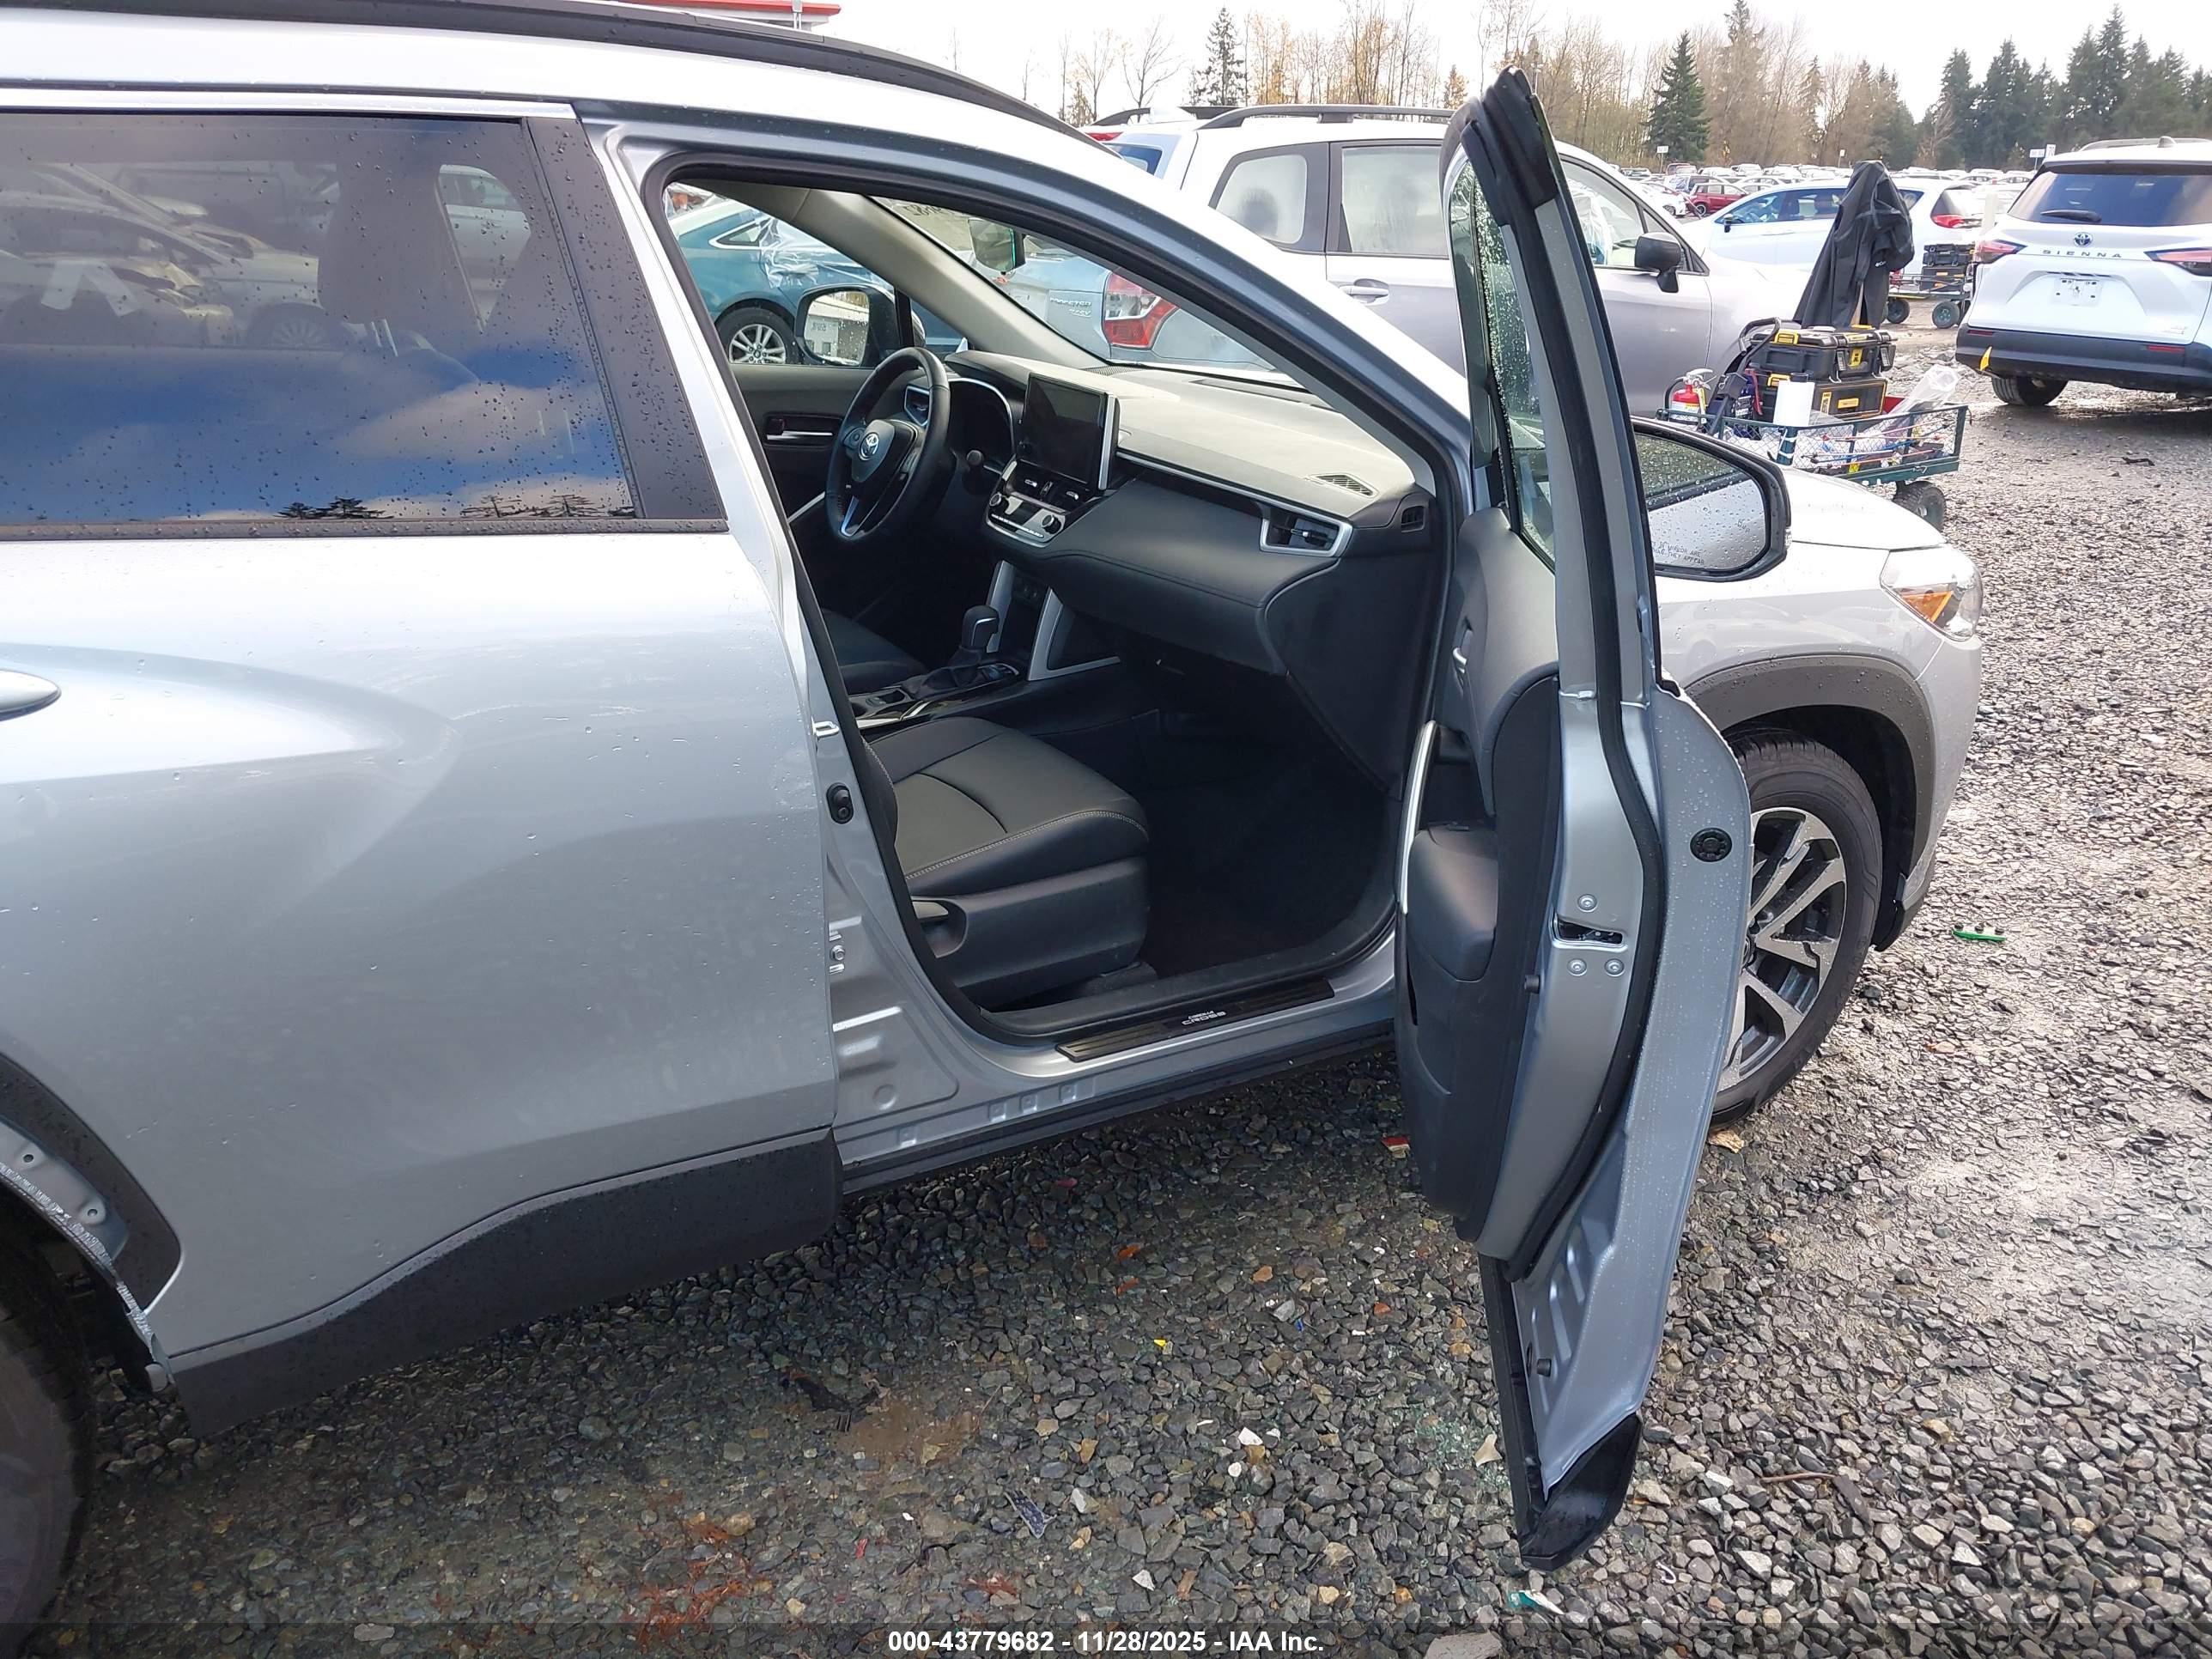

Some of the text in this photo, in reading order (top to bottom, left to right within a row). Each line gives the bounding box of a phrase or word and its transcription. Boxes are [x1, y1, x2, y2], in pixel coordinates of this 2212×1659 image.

[2042, 249, 2122, 258] SIENNA
[1690, 550, 1701, 558] ARE
[1683, 555, 1705, 566] APPEAR
